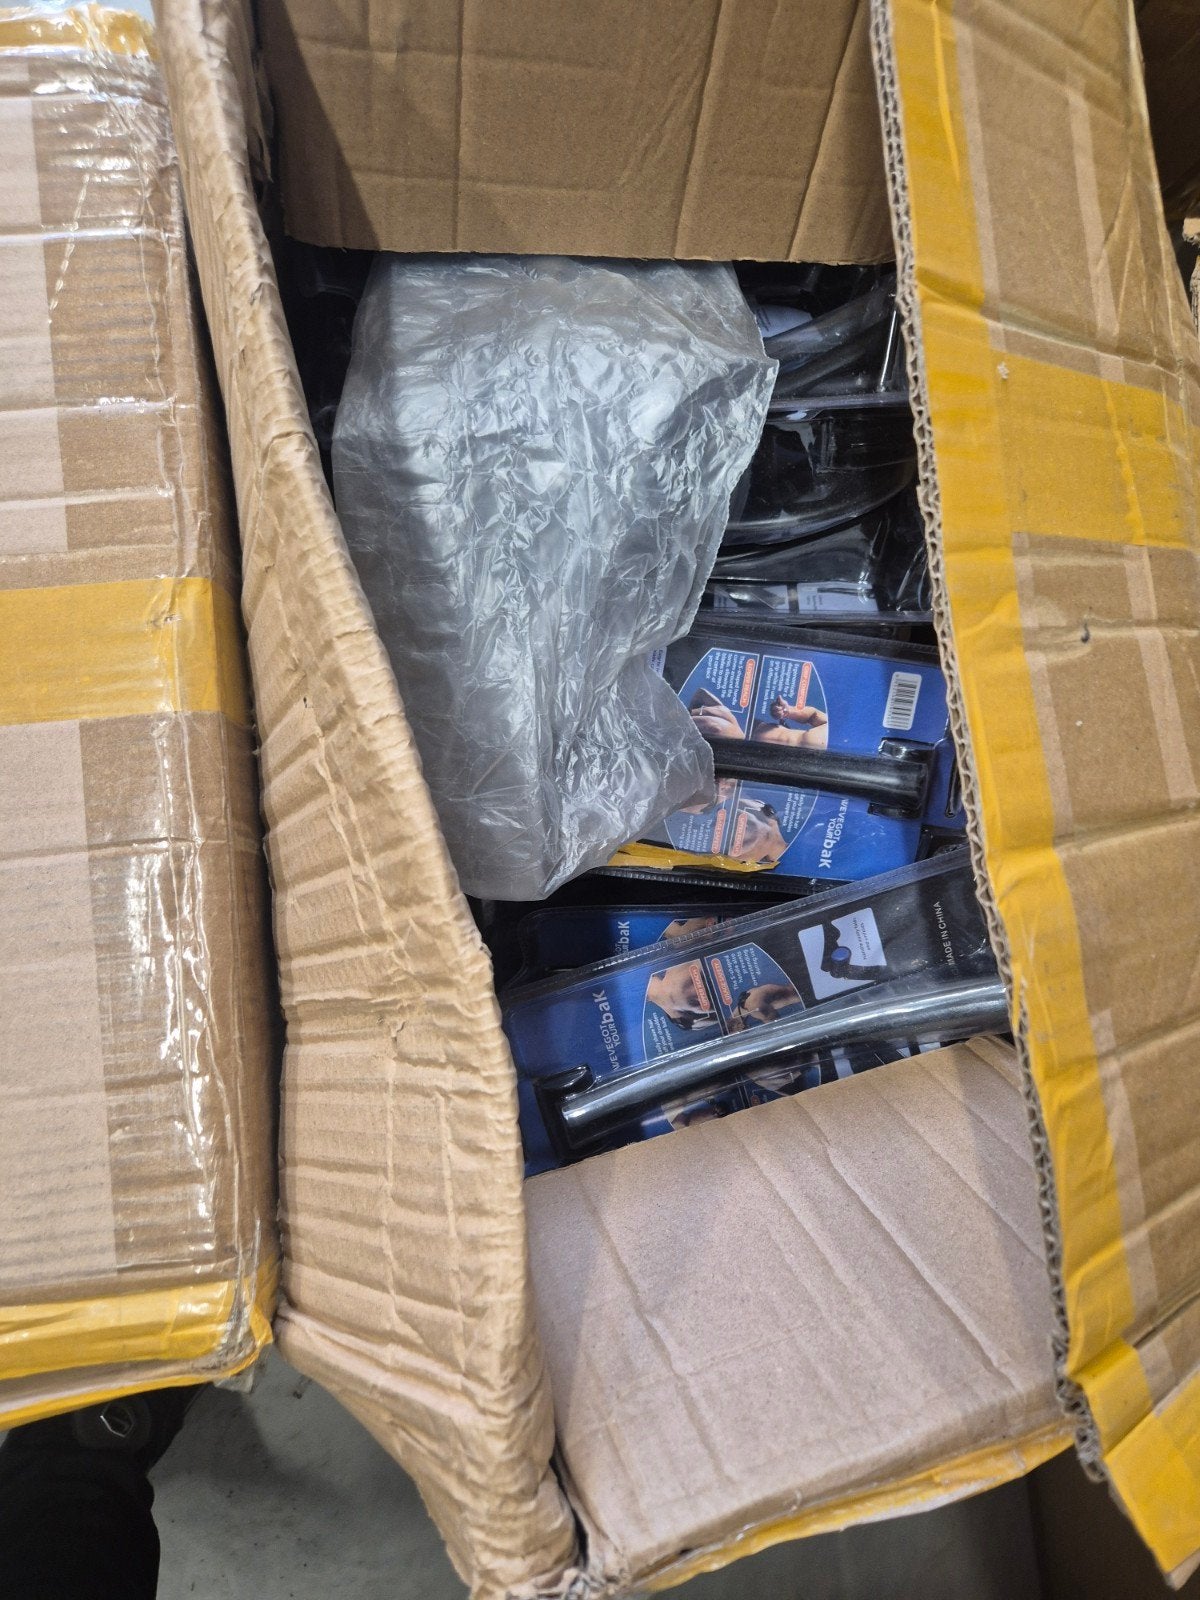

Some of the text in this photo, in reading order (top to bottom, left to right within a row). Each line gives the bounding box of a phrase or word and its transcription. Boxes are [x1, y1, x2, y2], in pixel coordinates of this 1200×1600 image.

[722, 668, 730, 689] allowing
[766, 668, 774, 689] different
[778, 662, 787, 691] comfortable
[785, 662, 793, 685] designed
[788, 663, 799, 698] Ergonomically
[798, 794, 806, 807] Easily
[787, 811, 795, 833] shoulders
[826, 817, 836, 839] YOUR
[933, 901, 956, 966] MADE IN CHINA
[724, 954, 735, 979] S-shaped
[738, 950, 748, 974] prevents
[743, 949, 757, 986] overextending
[734, 964, 743, 983] handle
[698, 988, 708, 1006] UPPER
[652, 1012, 663, 1036] shoulders
[660, 1016, 668, 1028] back
[608, 1023, 621, 1047] YOUR
[650, 1028, 659, 1043] shave
[664, 1028, 673, 1042] upper
